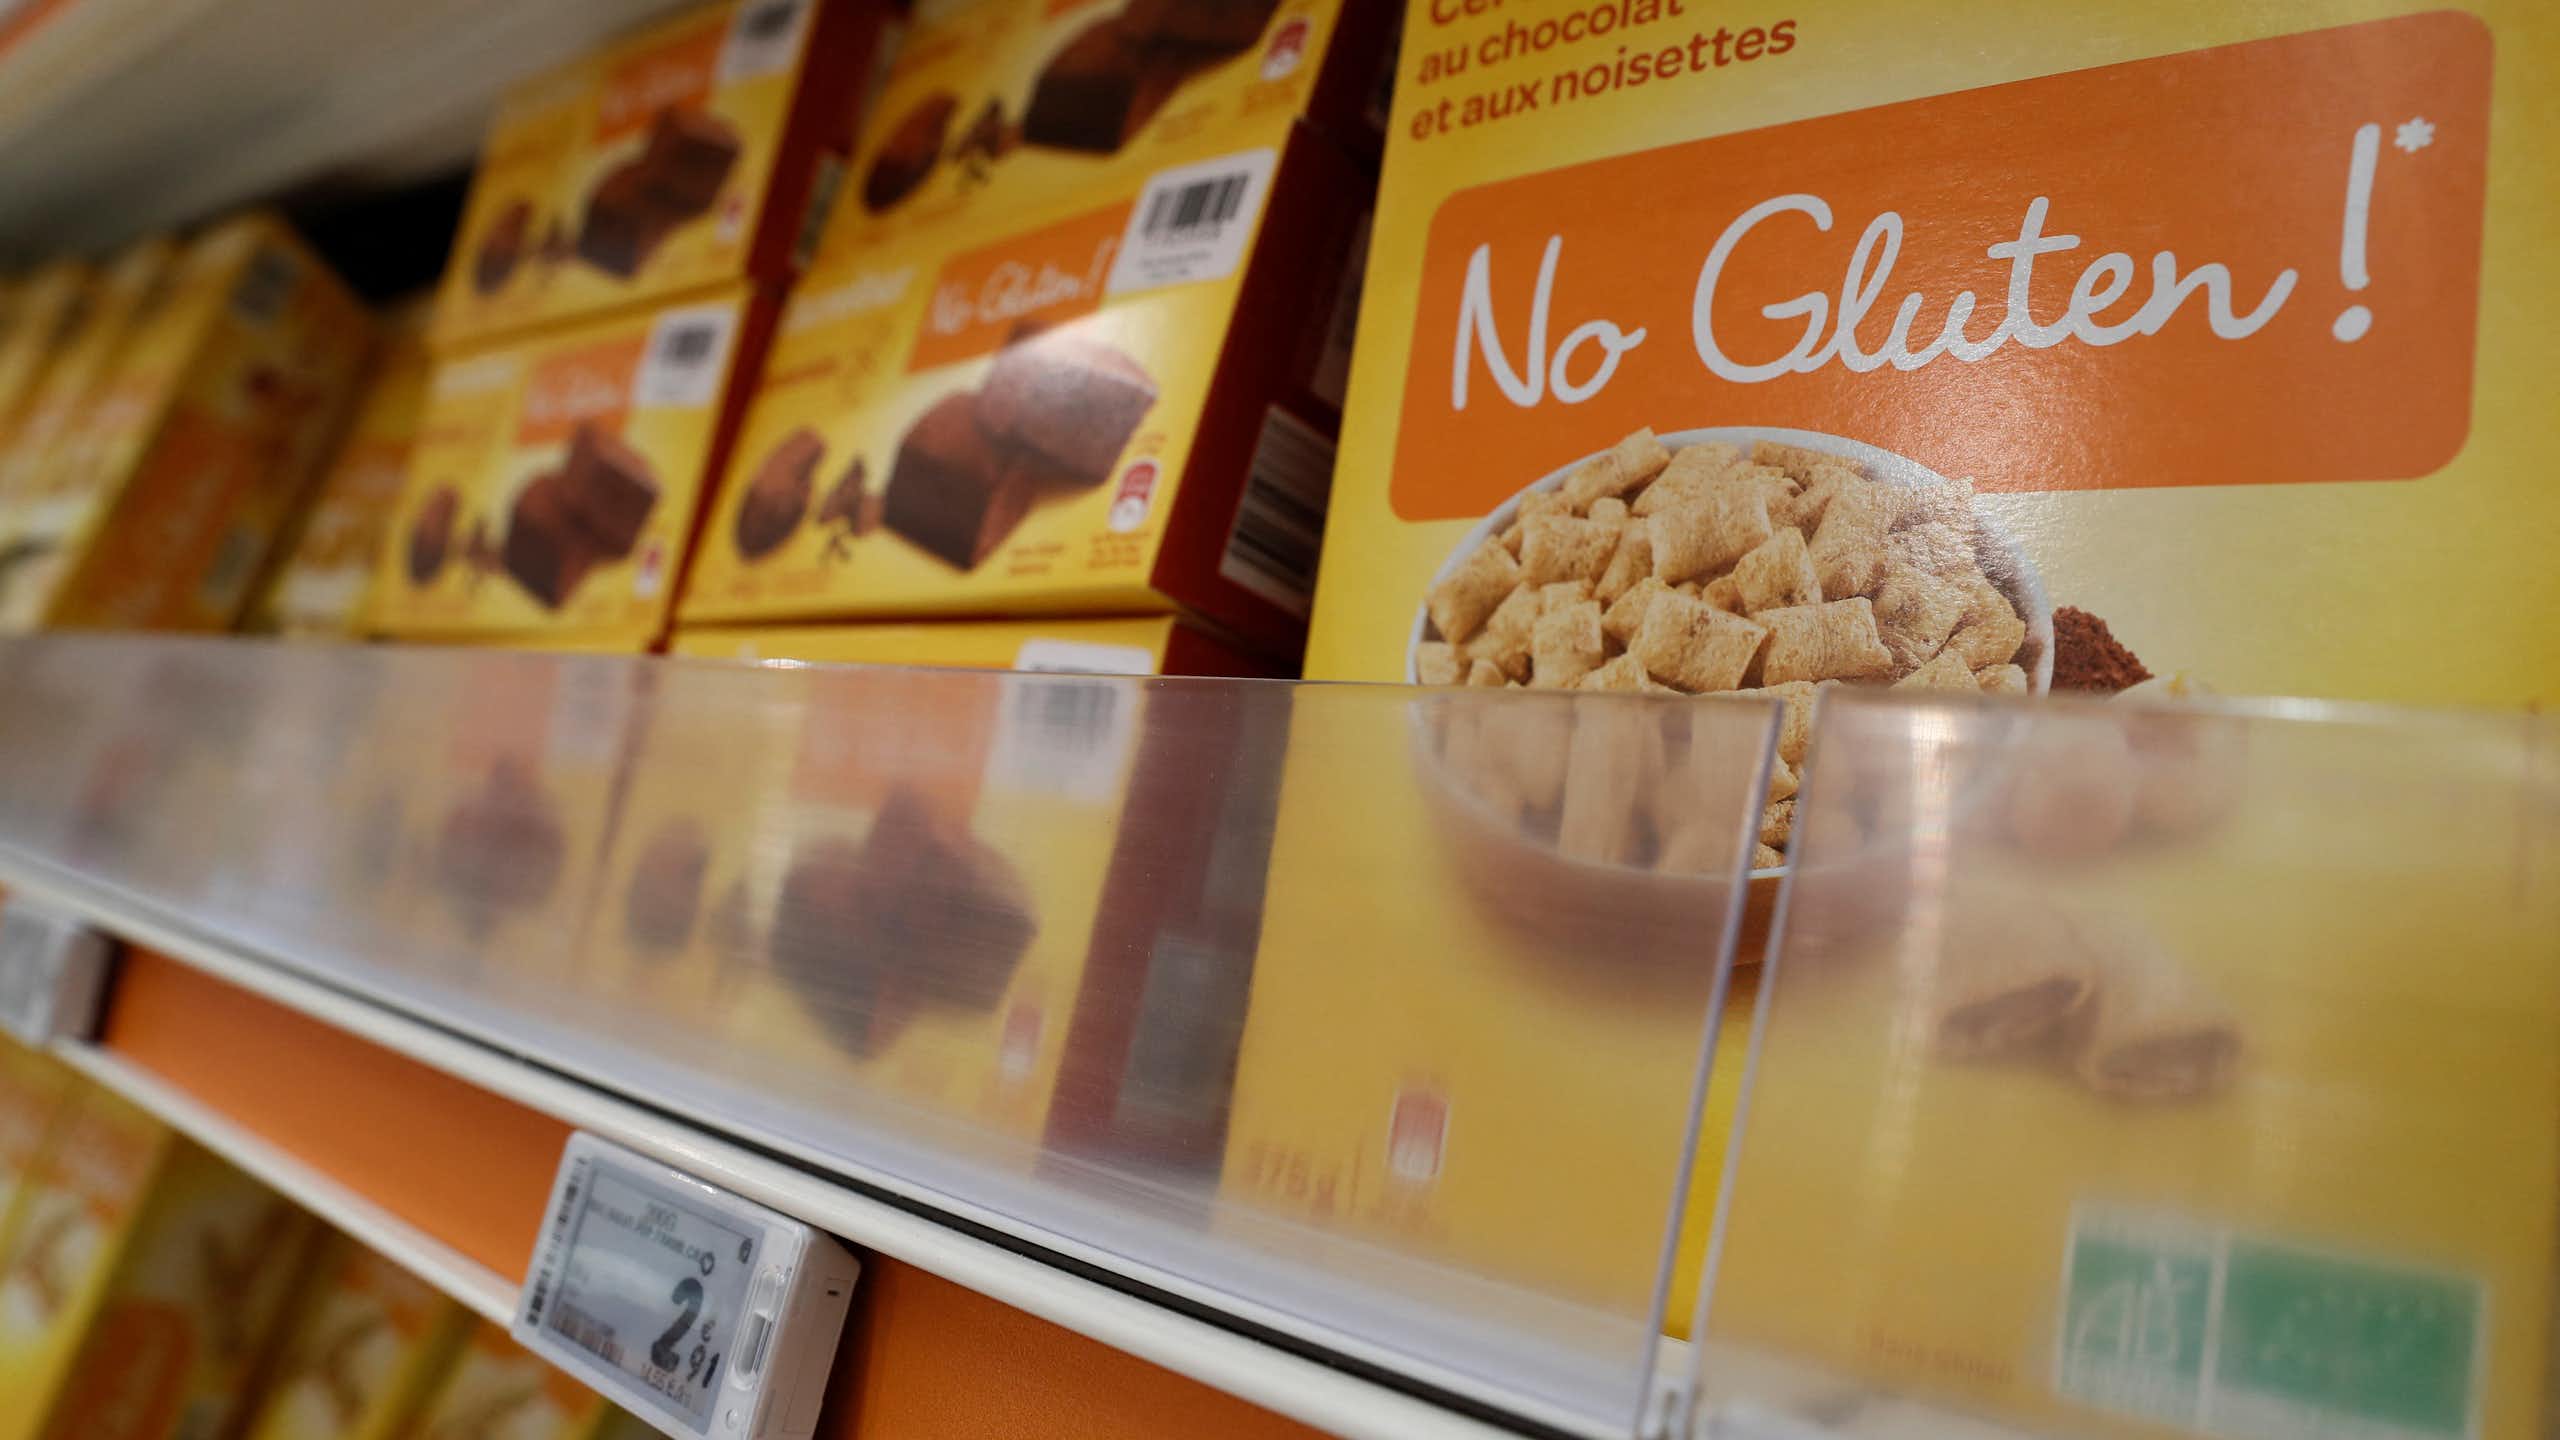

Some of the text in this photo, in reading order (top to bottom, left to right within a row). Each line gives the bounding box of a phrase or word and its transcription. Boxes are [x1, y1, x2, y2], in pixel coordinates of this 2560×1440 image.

[1410, 18, 1798, 142] et aux noisettes
[1417, 43, 1469, 86] au
[1453, 237, 1645, 409] No
[650, 1276, 704, 1373] 2
[686, 1344, 720, 1388] 91
